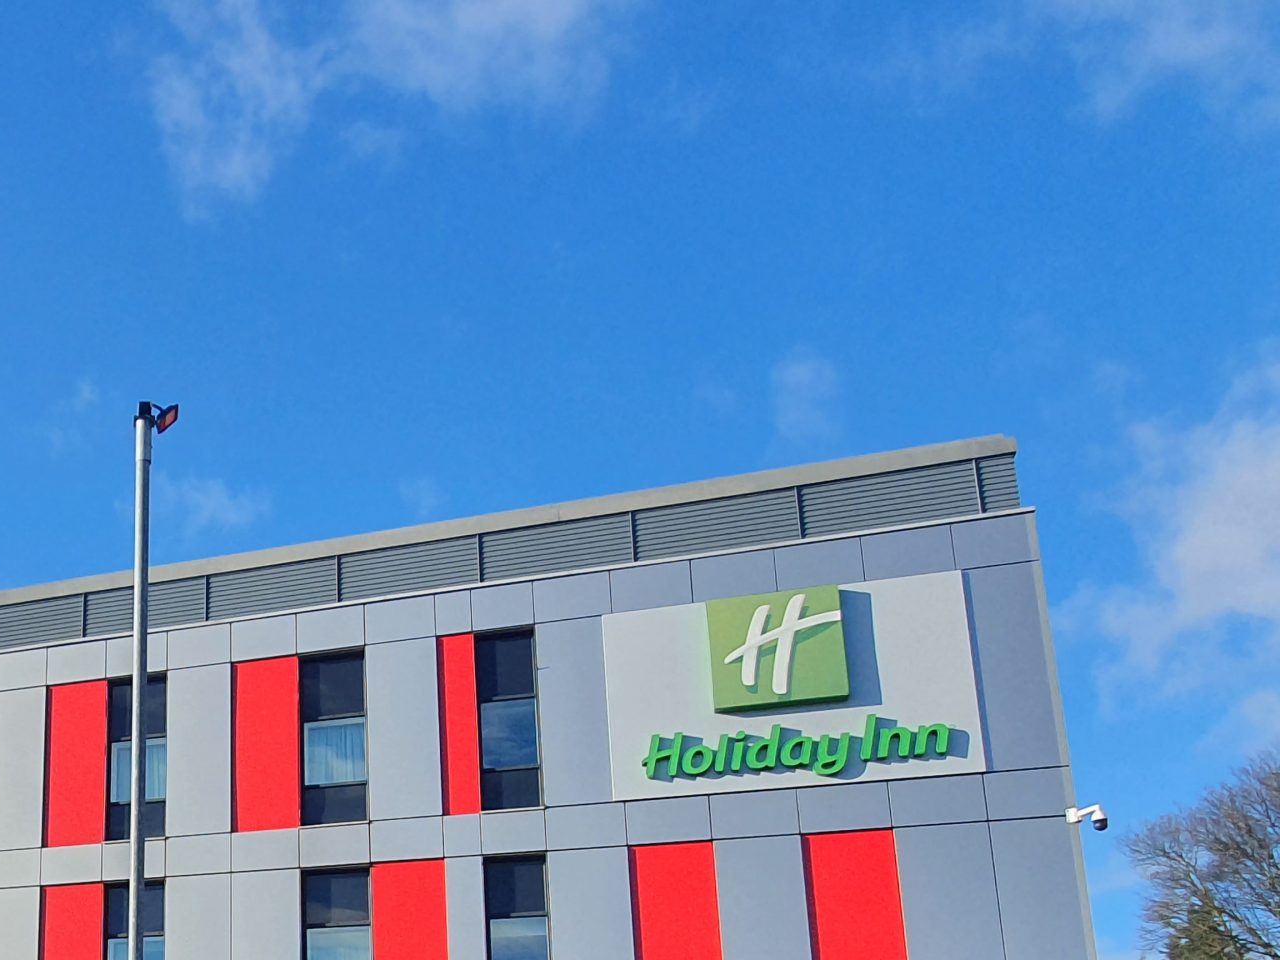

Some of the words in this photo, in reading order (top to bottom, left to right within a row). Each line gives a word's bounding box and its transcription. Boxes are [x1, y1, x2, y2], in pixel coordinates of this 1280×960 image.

[723, 593, 841, 695] H
[642, 724, 848, 778] Holiday
[860, 713, 950, 761] Inn
